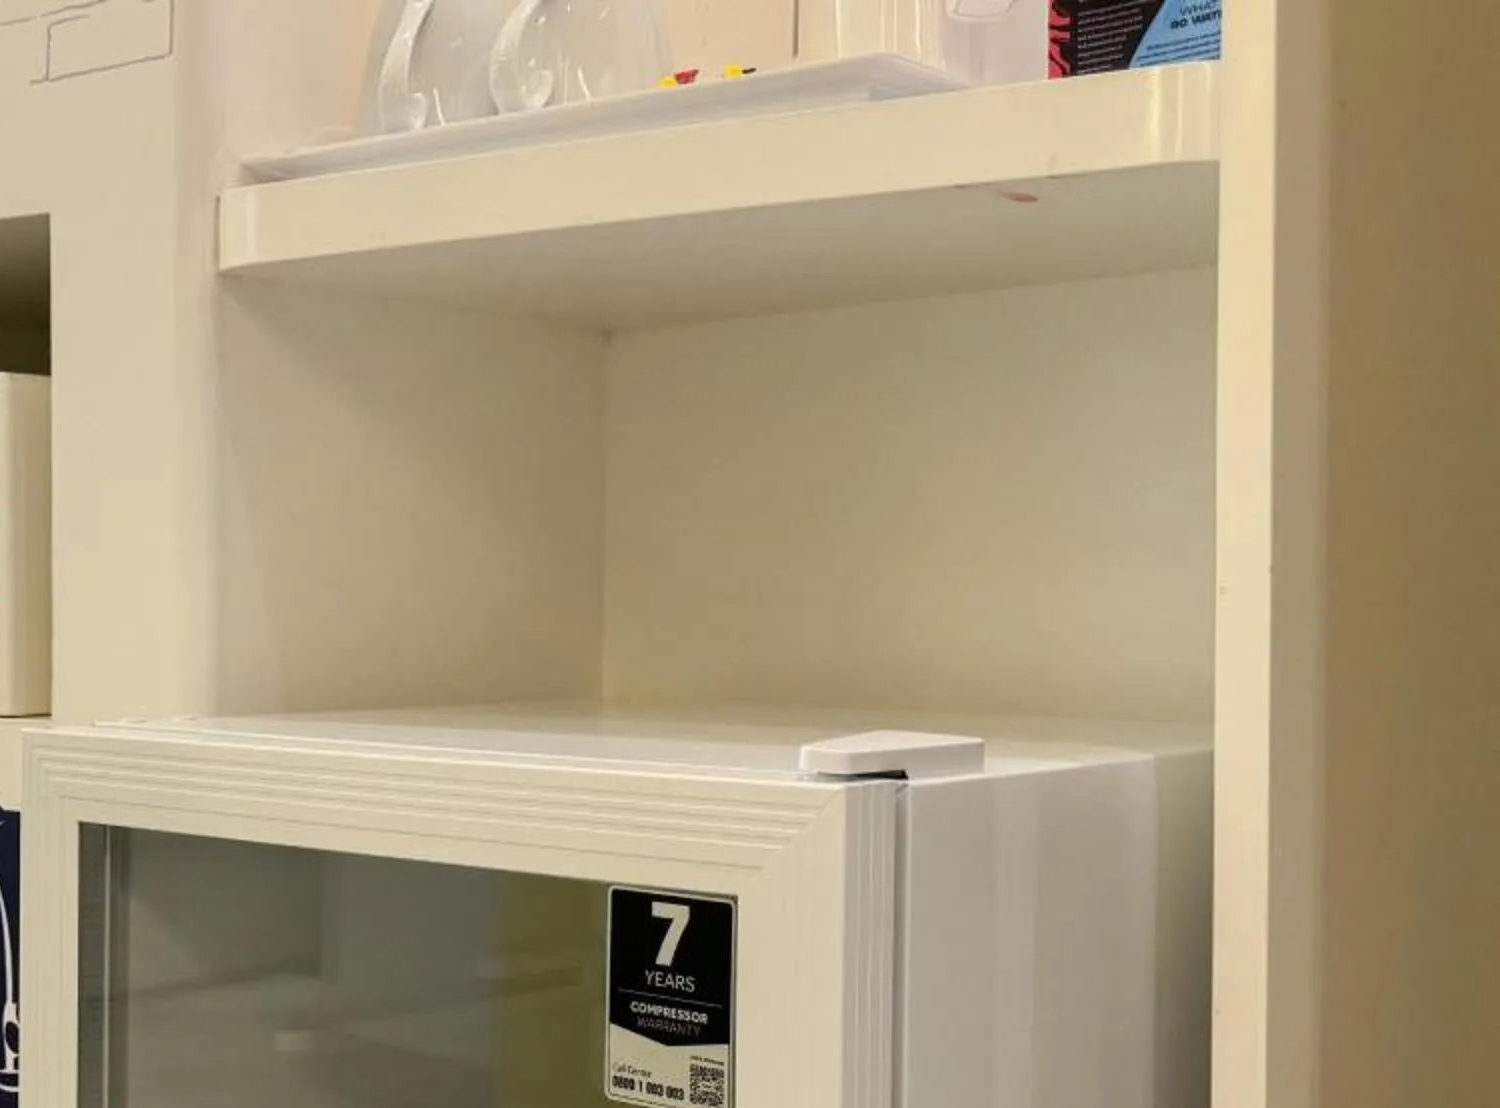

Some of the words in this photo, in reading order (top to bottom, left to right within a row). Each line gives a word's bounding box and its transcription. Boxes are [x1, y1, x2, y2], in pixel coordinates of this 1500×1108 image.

[651, 901, 690, 966] 7
[644, 969, 696, 992] YEARS
[629, 1001, 709, 1025] COMPRESSOR
[636, 1016, 701, 1037] WARRANTY
